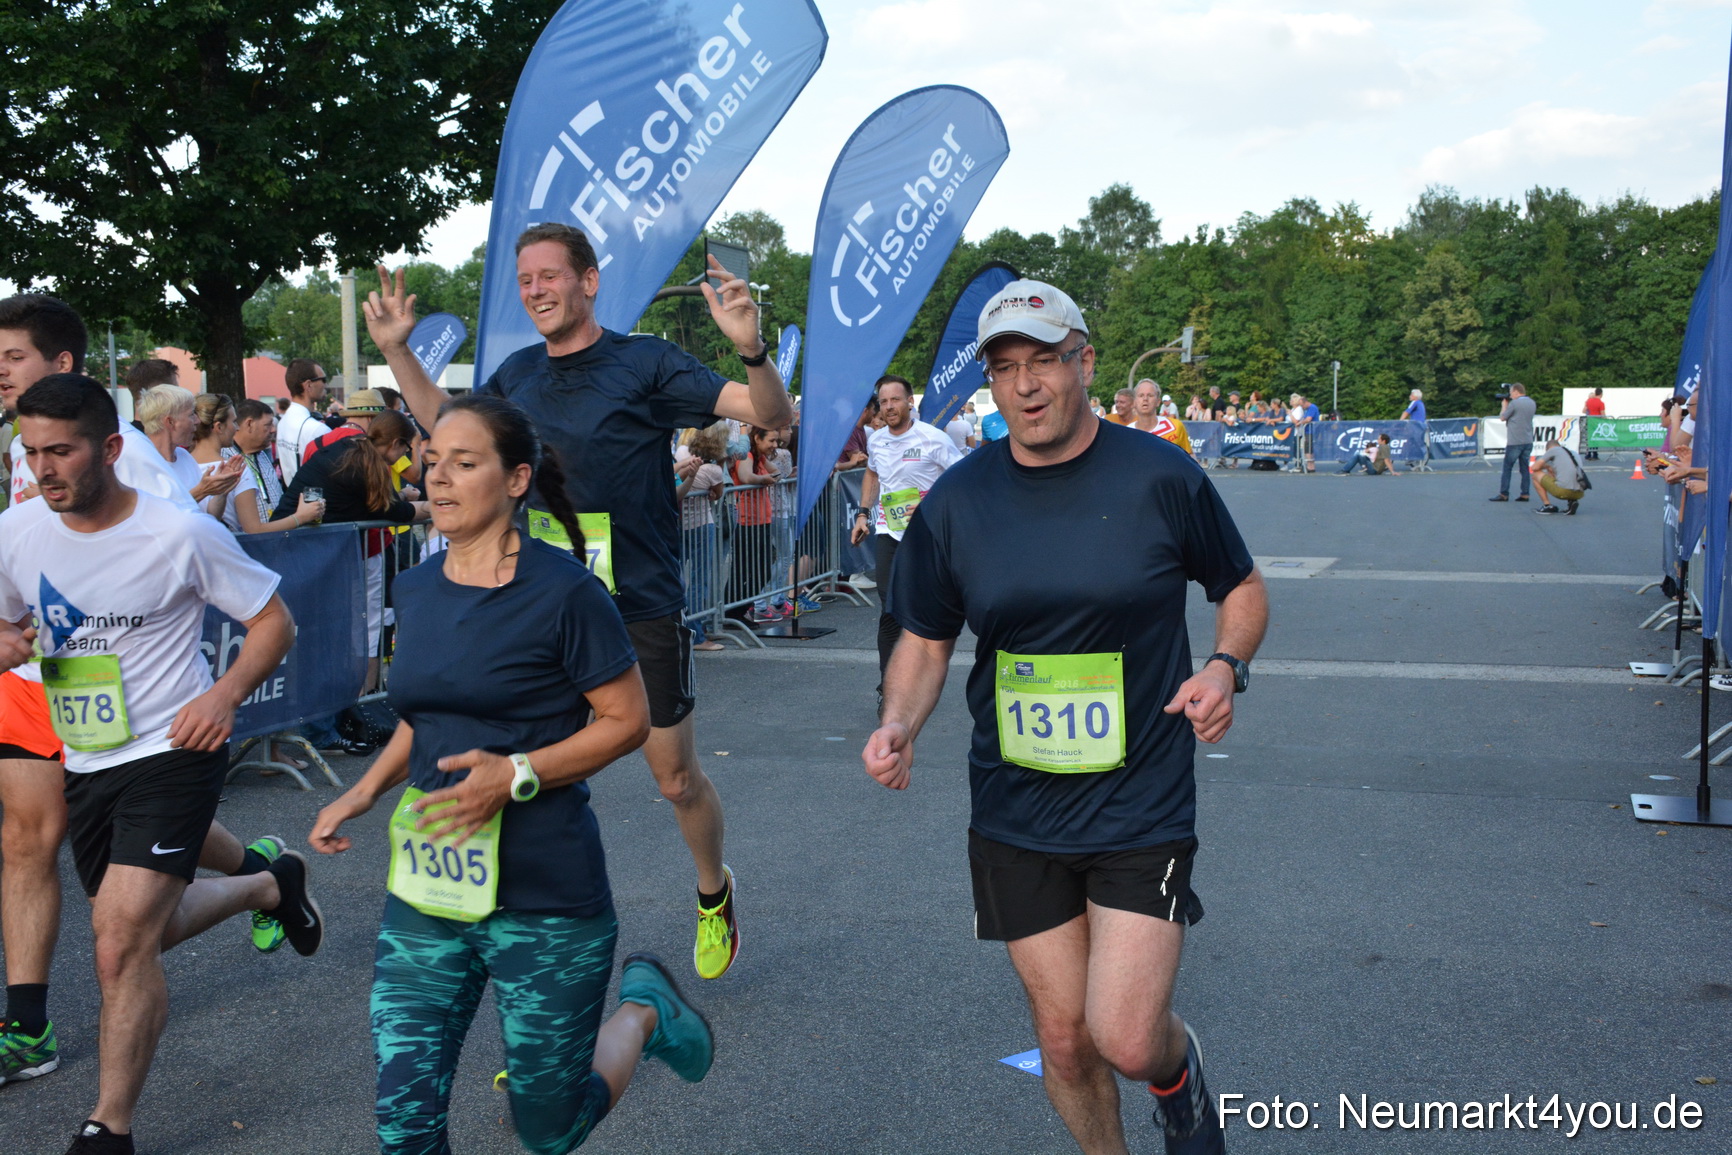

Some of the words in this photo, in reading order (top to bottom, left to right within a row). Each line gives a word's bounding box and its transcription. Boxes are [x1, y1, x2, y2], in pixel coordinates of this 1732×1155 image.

[570, 2, 752, 245] Fischer
[632, 49, 774, 243] AUTOMOBILE
[854, 122, 963, 299] Fischer
[893, 153, 976, 295] AUTOMOBILE
[421, 324, 454, 370] ischer
[932, 337, 980, 395] Frischm
[1532, 426, 1557, 442] wn
[1592, 422, 1618, 438] AOK
[1628, 422, 1668, 433] GESUND
[1187, 435, 1206, 448] her
[1223, 432, 1274, 445] Frischmann
[1348, 436, 1408, 450] Fiser
[1429, 430, 1466, 444] Frischmann
[1009, 673, 1053, 684] firmenlauf
[1053, 679, 1079, 689] 2016
[53, 693, 116, 725] 1578
[1008, 699, 1110, 740] 1310
[1032, 746, 1056, 756] Stefan
[1057, 748, 1083, 756] Hauck
[402, 838, 488, 887] 1305
